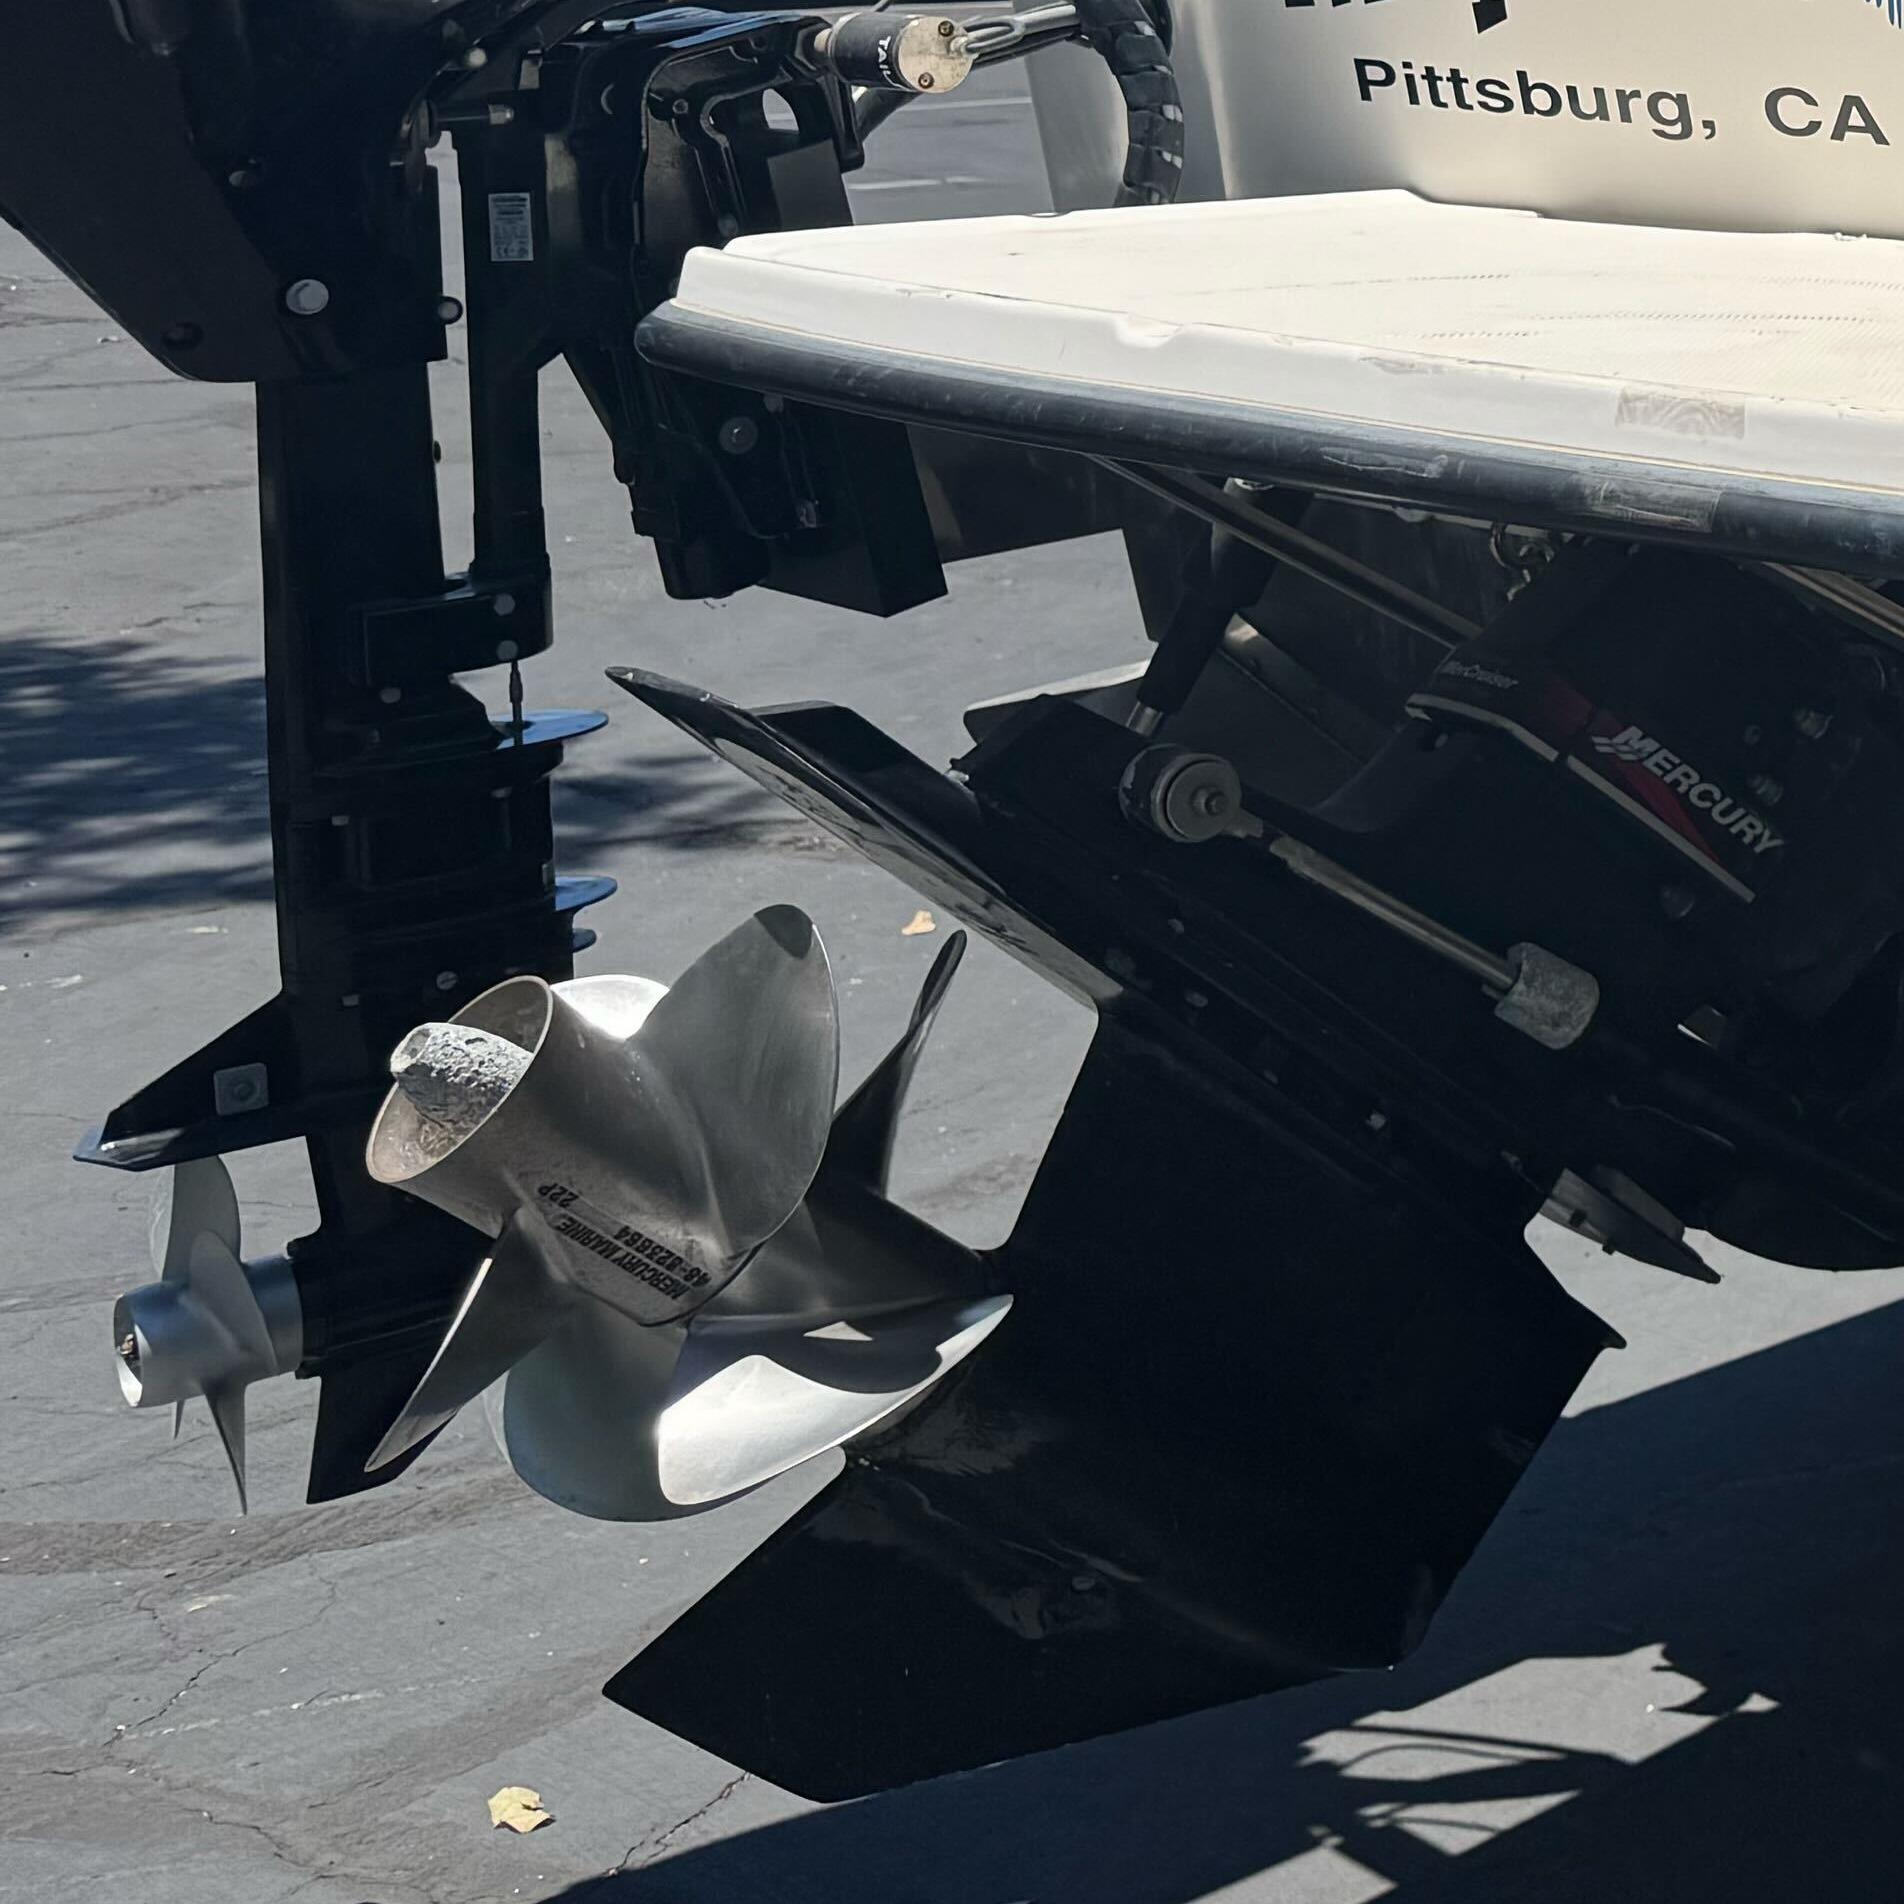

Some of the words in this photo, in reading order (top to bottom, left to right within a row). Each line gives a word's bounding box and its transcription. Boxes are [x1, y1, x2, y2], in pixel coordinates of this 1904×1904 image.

[1353, 56, 1719, 141] Pittsburg,
[1765, 85, 1891, 147] CA
[1600, 725, 1785, 855] MERCURY
[537, 1181, 579, 1209] 22P
[555, 1216, 625, 1264] MARINE
[610, 1253, 691, 1301] MERCURY
